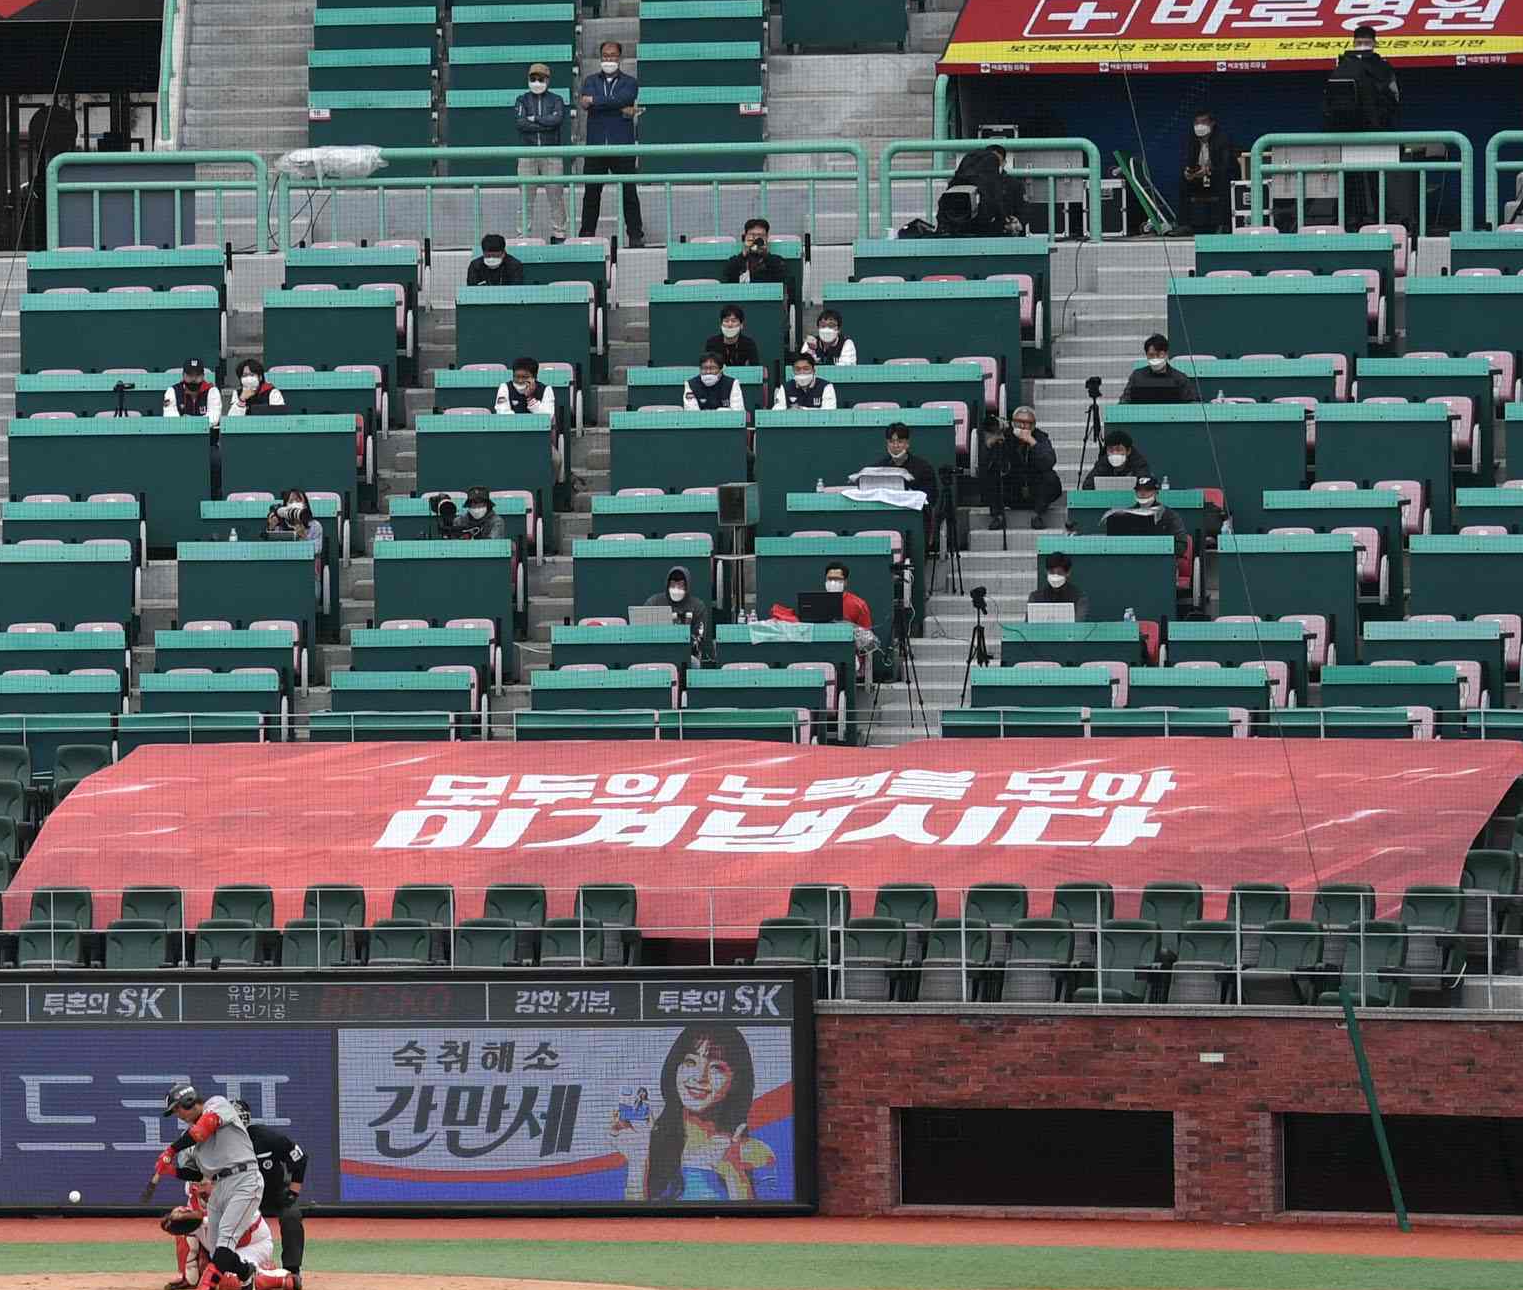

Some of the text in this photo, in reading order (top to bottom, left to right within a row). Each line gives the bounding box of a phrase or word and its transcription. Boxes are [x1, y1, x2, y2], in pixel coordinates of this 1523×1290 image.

[416, 773, 692, 807] 모두의
[995, 768, 1179, 803] 모아
[42, 986, 167, 1019] 투혼의 SK
[514, 990, 617, 1016] 강한 기본,
[657, 984, 784, 1017] 투혼의 SK
[391, 1040, 561, 1074] 숙취해소
[367, 1082, 584, 1160] 간만세
